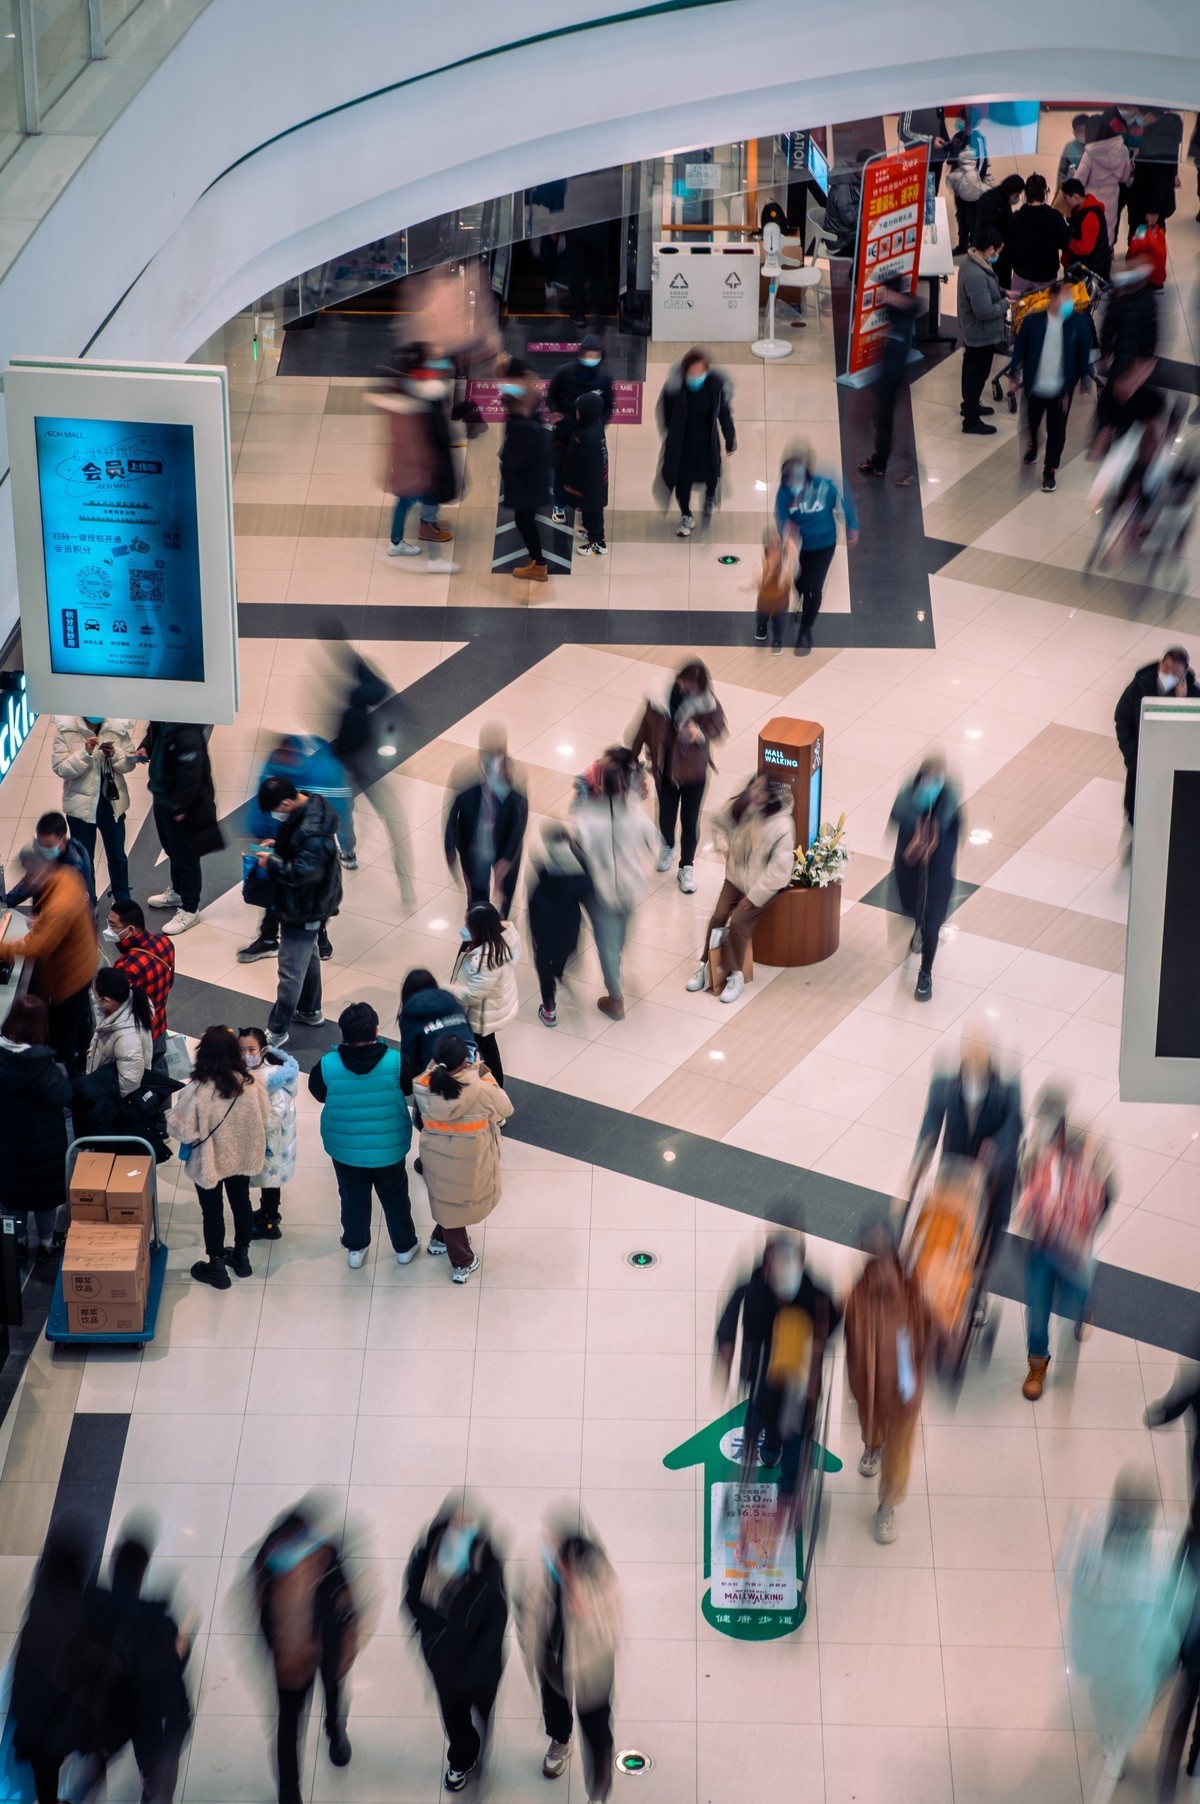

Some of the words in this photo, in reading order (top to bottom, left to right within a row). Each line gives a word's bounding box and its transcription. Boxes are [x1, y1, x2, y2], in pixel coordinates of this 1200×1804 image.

[64, 431, 84, 439] MALL
[81, 459, 125, 481] 会员
[52, 532, 122, 544] 扫码一键授权开通
[54, 544, 91, 554] 会员积分
[66, 611, 76, 647] 积分有妙用
[765, 748, 784, 758] MALL
[765, 755, 798, 767] WALKING
[74, 1276, 92, 1284] 椰浆
[75, 1285, 93, 1293] 饮品
[80, 1308, 98, 1316] 椰浆
[81, 1316, 99, 1324] 饮品
